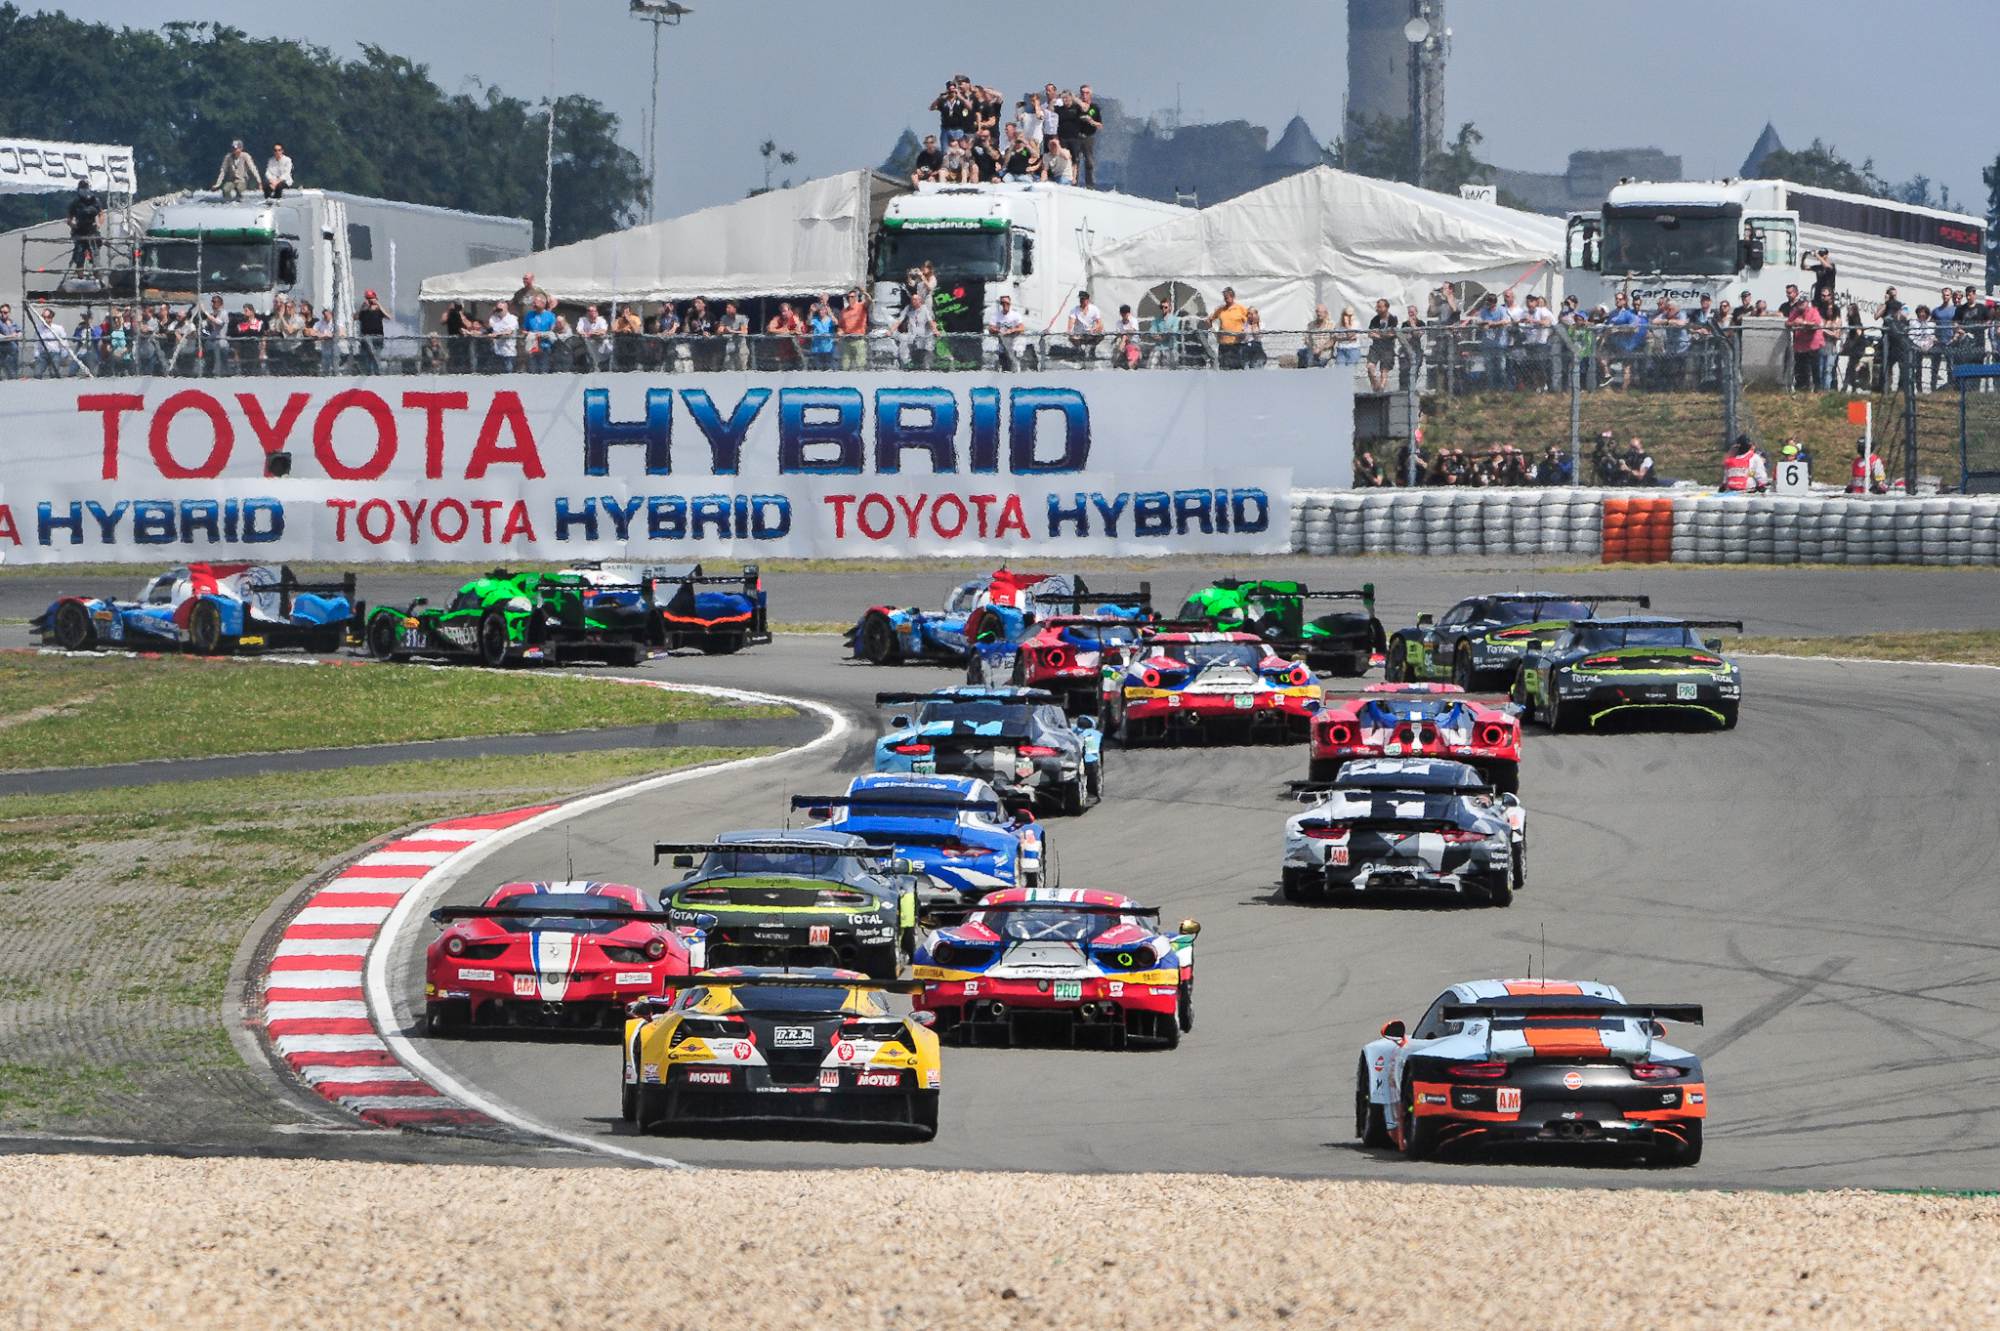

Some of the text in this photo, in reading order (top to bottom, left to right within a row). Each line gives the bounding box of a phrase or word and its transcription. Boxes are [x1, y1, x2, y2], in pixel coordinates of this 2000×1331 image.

[1631, 288, 1700, 299] CarTech
[78, 387, 1090, 480] TOYOTA HYBRID
[1785, 465, 1799, 487] 6
[38, 498, 284, 545] HYBRID
[327, 498, 536, 545] TOYOTA
[556, 495, 791, 541] HYBRID
[825, 493, 1029, 539] TOYOTA
[1048, 488, 1269, 538] HYBRID
[1486, 645, 1518, 654] TOTAL
[1572, 674, 1602, 682] TOTAL
[845, 913, 883, 925] TOTAL
[811, 929, 829, 943] AM
[517, 978, 534, 993] AM
[1055, 983, 1079, 998] PRO
[689, 1072, 730, 1084] MOTUL
[822, 1071, 838, 1084] AM
[857, 1075, 898, 1086] MOTUL
[1500, 1092, 1519, 1109] AM
